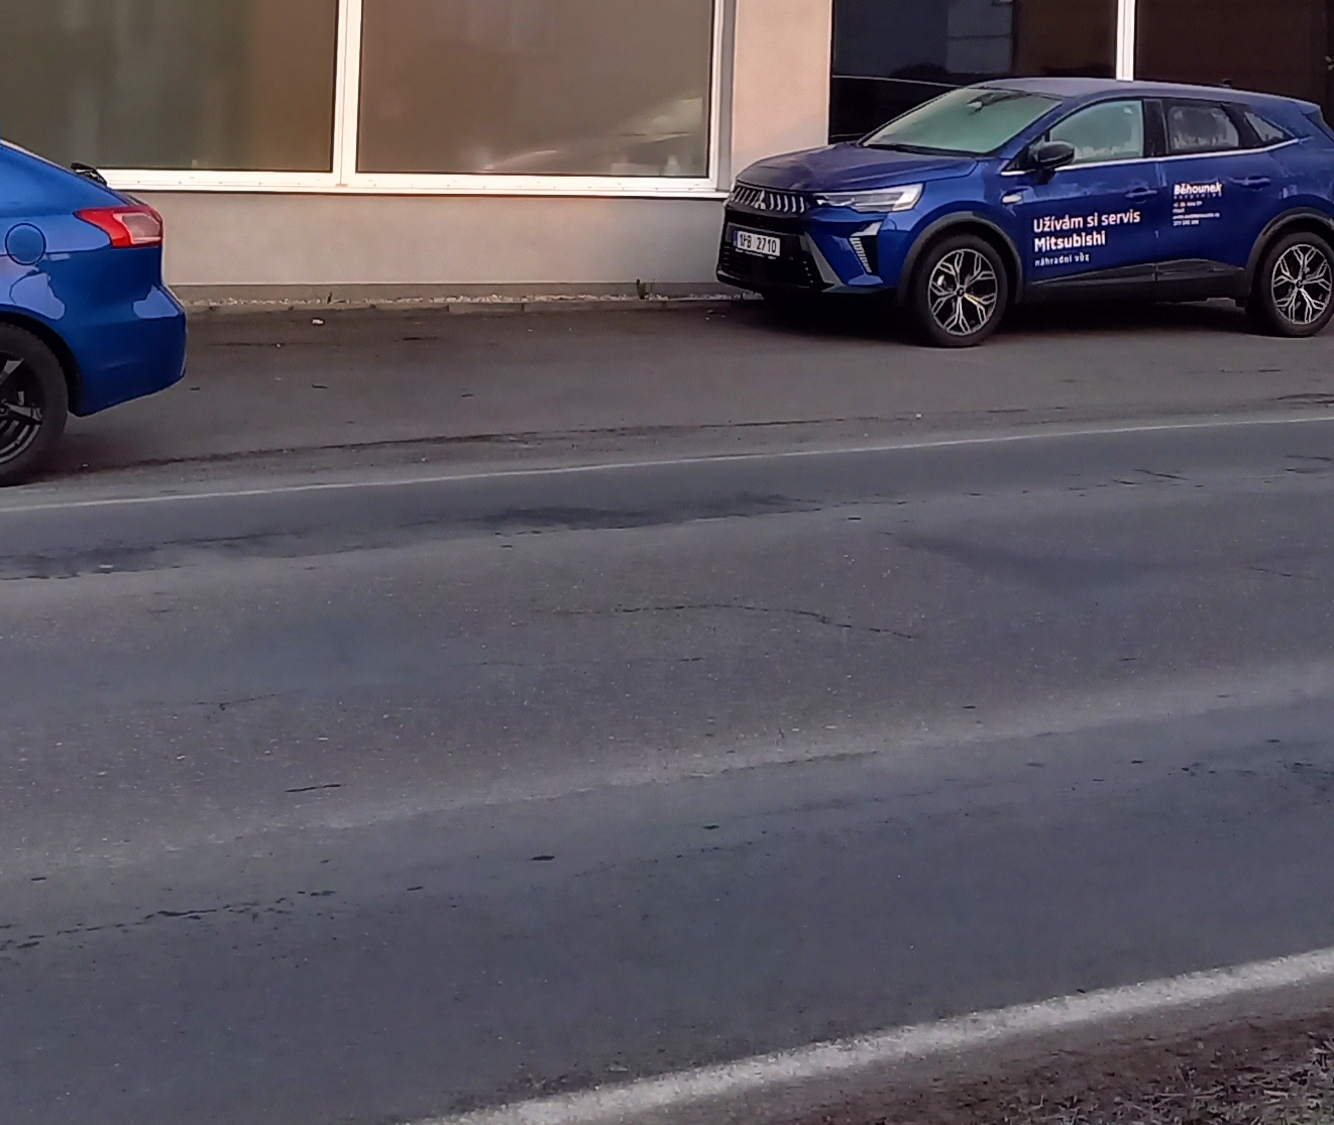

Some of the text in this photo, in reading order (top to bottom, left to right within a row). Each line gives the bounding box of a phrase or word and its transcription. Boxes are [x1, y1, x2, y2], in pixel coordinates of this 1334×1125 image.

[1033, 208, 1142, 233] Užívám si servis
[756, 236, 777, 254] 2710
[1033, 230, 1106, 253] Mitsubishi
